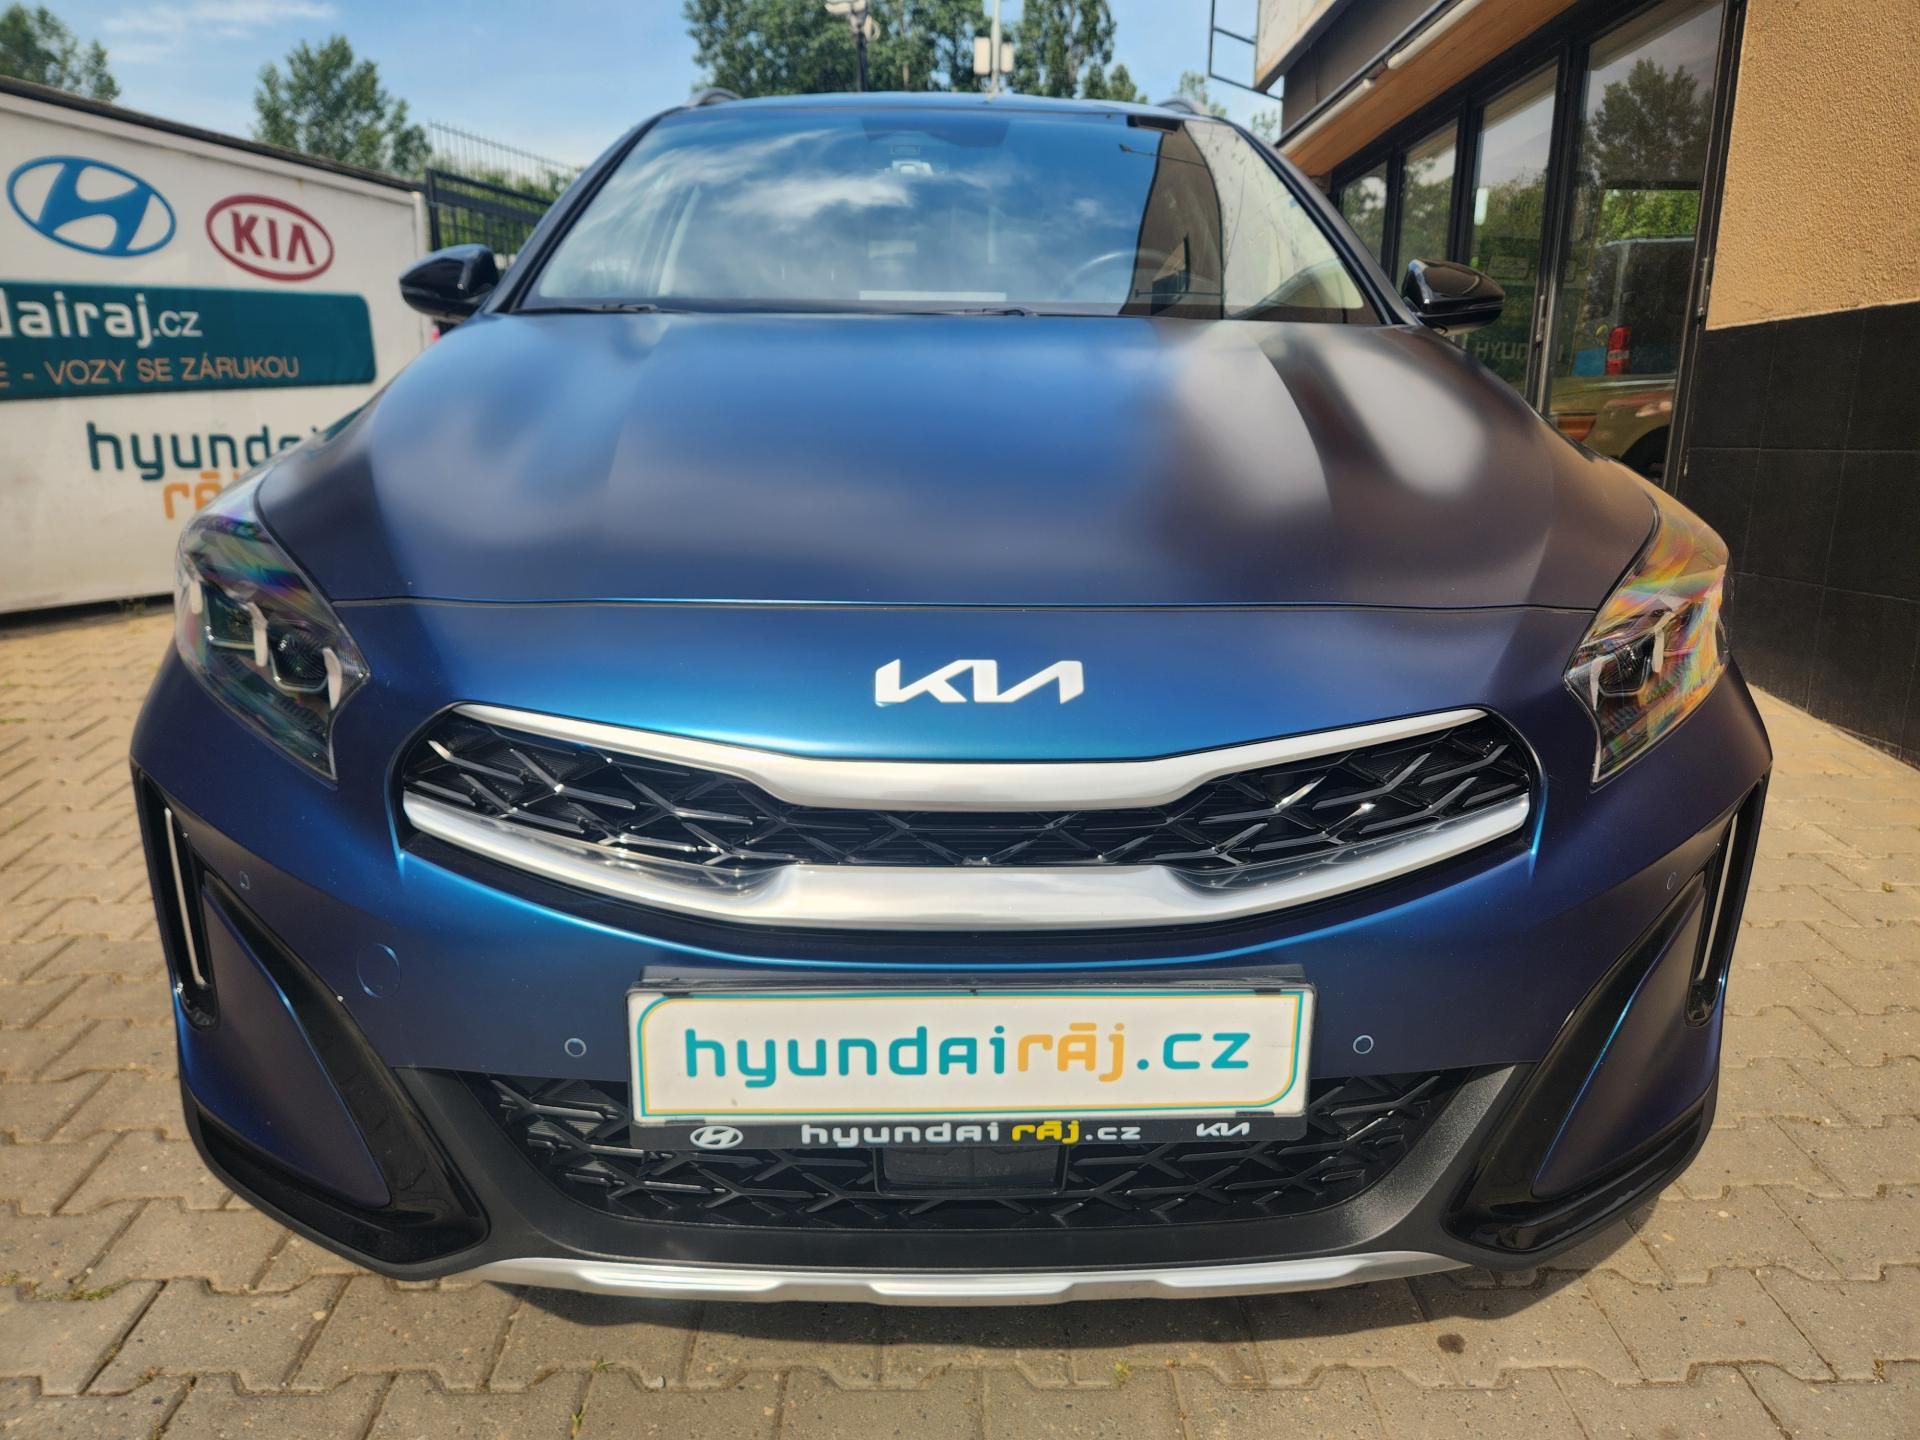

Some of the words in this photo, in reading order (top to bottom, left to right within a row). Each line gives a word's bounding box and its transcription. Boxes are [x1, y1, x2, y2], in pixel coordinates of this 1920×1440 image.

[229, 208, 316, 267] KIA
[44, 359, 126, 385] VOZY
[136, 357, 174, 382] SE
[179, 351, 300, 381] ZÁRUKOU
[875, 659, 1084, 704] KIA
